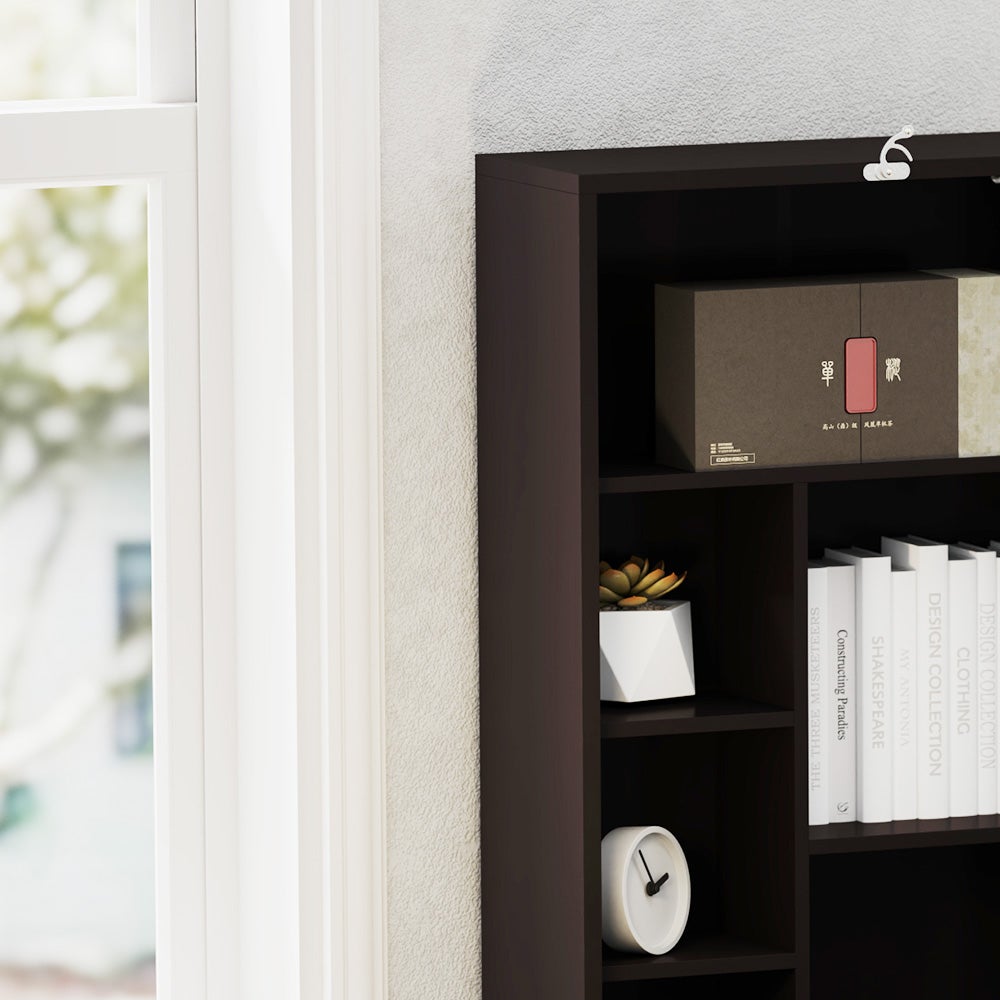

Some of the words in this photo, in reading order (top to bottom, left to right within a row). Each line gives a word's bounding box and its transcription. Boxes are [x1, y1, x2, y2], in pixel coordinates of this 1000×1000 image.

[810, 607, 821, 704] MUSKETEERS
[928, 592, 941, 657] DESIGN
[980, 603, 995, 663] DESIGN
[834, 629, 848, 695] Constructing
[871, 636, 885, 749] SHAKESPEARE
[899, 648, 910, 671] MY
[956, 647, 971, 735] CLOTHING
[811, 709, 821, 757] THREE
[899, 676, 910, 747] ANTONIA
[928, 663, 942, 777] COLLECTION
[980, 669, 997, 769] COLLECTION
[811, 762, 821, 791] THE
